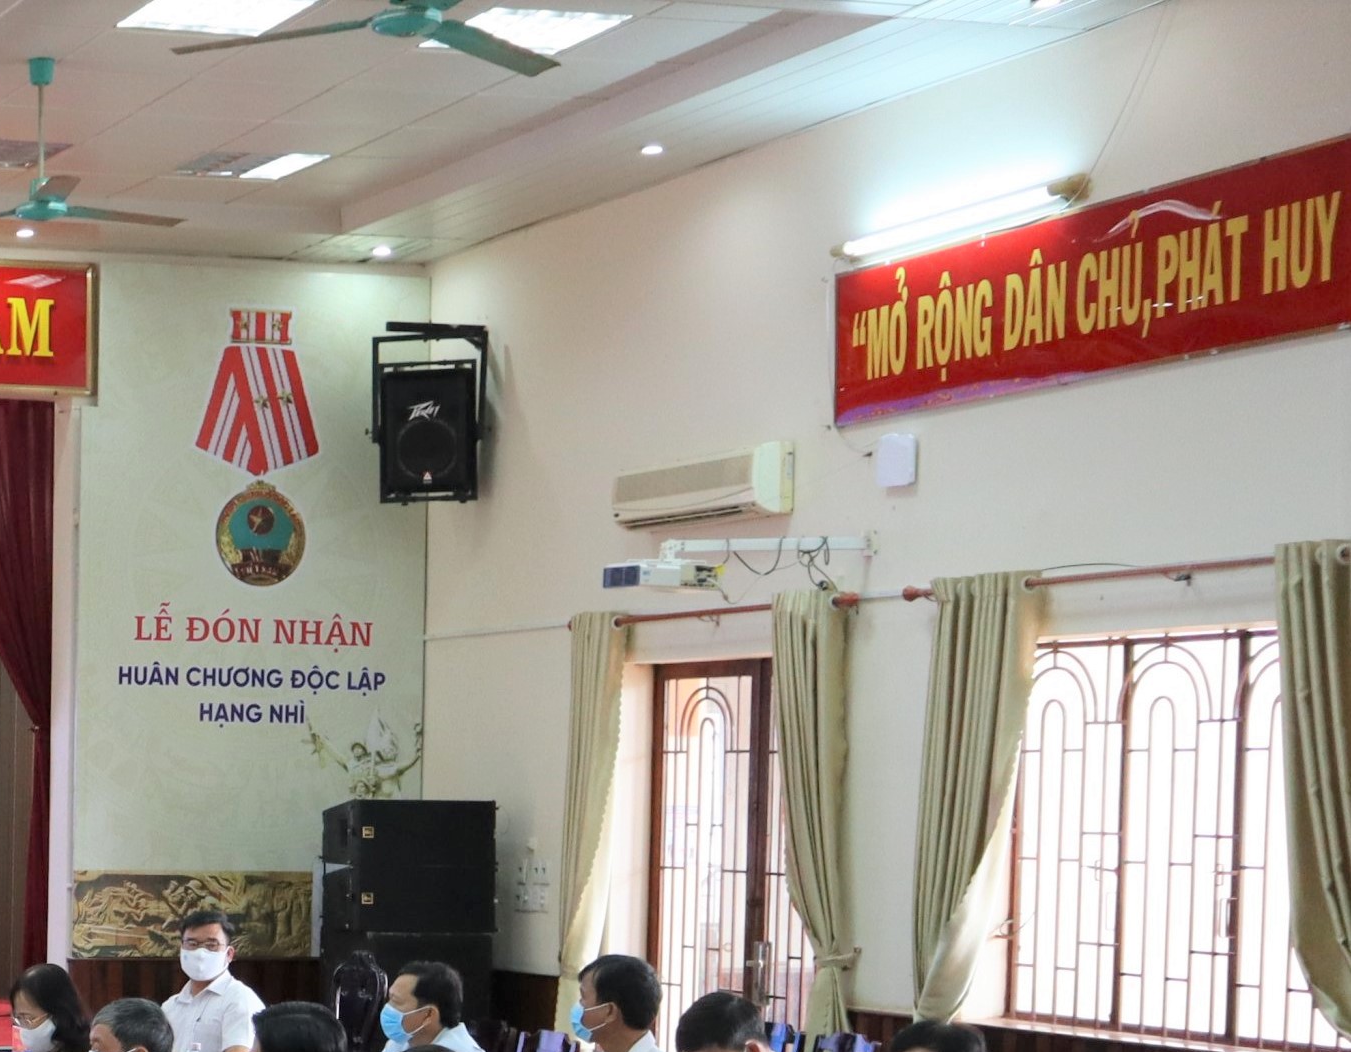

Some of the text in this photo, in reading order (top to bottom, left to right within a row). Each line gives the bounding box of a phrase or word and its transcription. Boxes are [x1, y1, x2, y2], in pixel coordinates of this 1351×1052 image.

[916, 272, 993, 382] RỘNG
[1004, 248, 1067, 351] DÂN
[1263, 191, 1341, 295] HUY
[134, 601, 374, 653] LỄ ĐÓN NHẬN
[118, 661, 386, 697] HUÂN CHƯƠNG ĐỘC LẬP
[199, 699, 305, 728] HẠNG NHÌ
